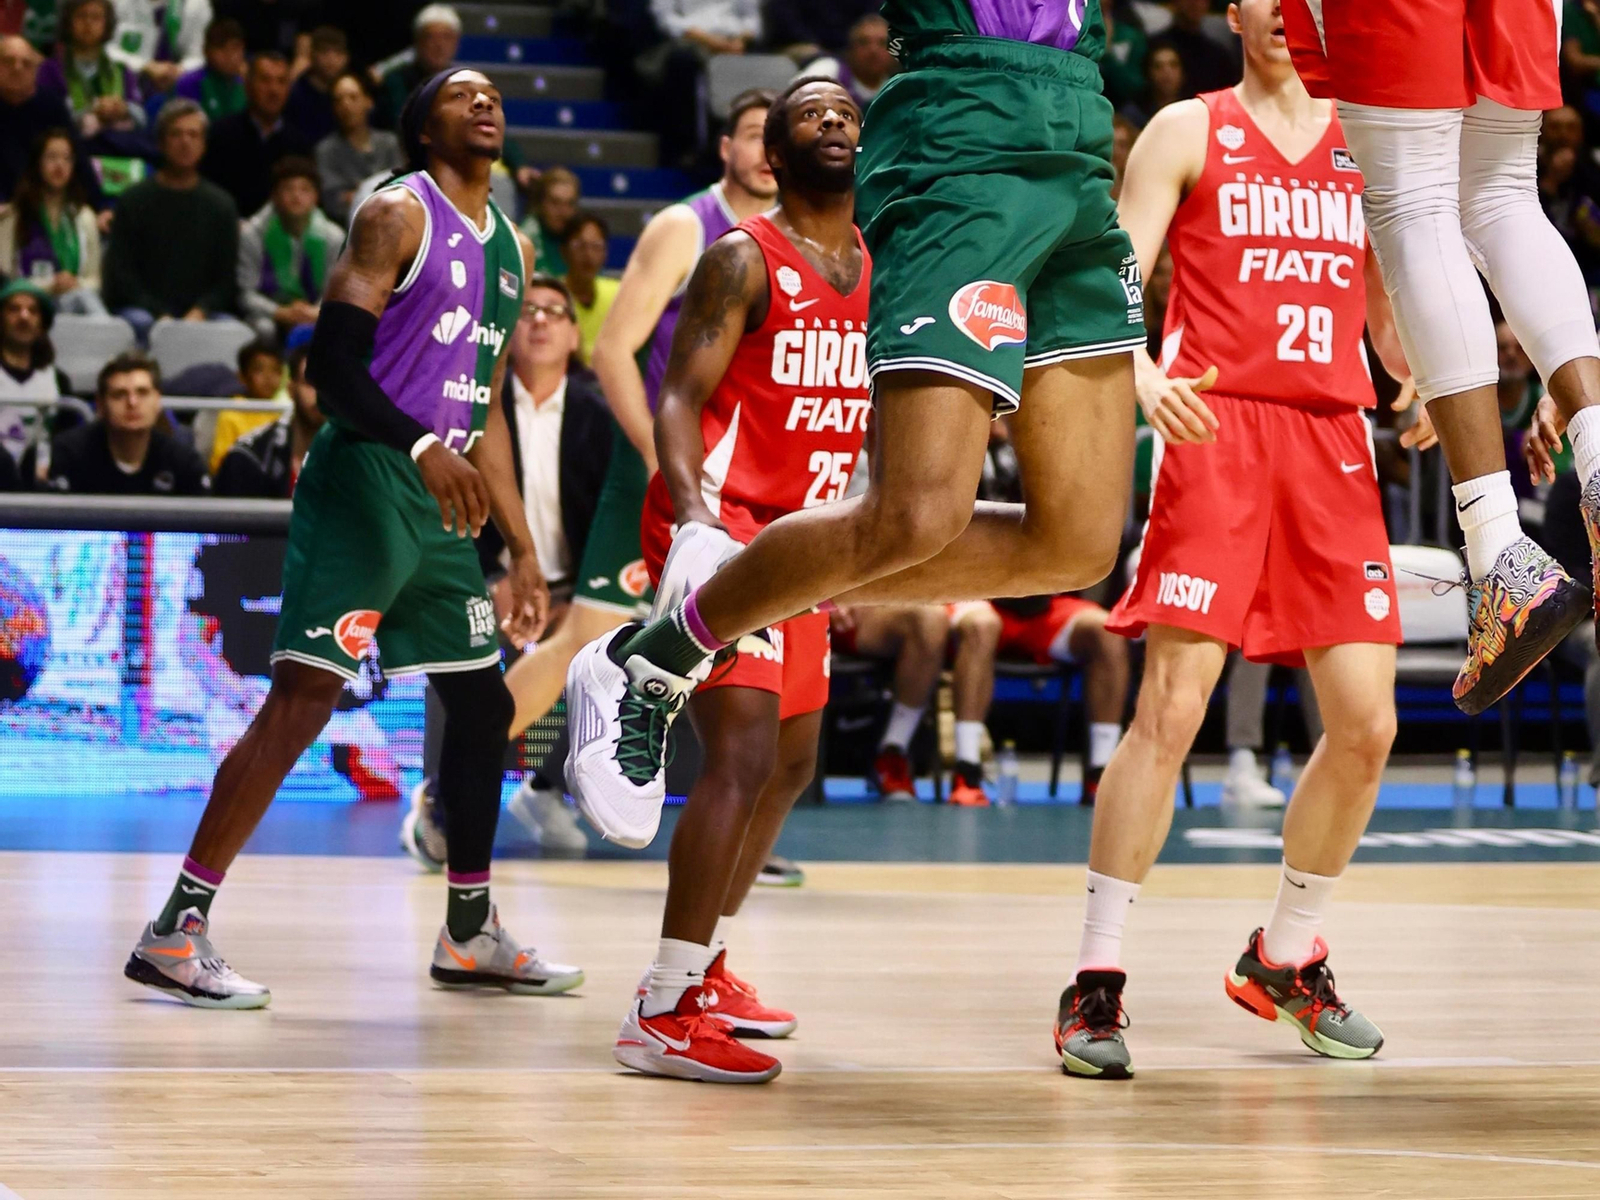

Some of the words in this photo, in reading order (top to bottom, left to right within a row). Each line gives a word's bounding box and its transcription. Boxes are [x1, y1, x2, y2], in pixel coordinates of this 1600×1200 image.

[1217, 182, 1365, 250] GIRONA
[1238, 248, 1355, 289] FIATC
[771, 329, 871, 389] GIRO
[1277, 303, 1334, 364] 29
[803, 450, 854, 509] 25
[1156, 572, 1219, 615] YOSOY
